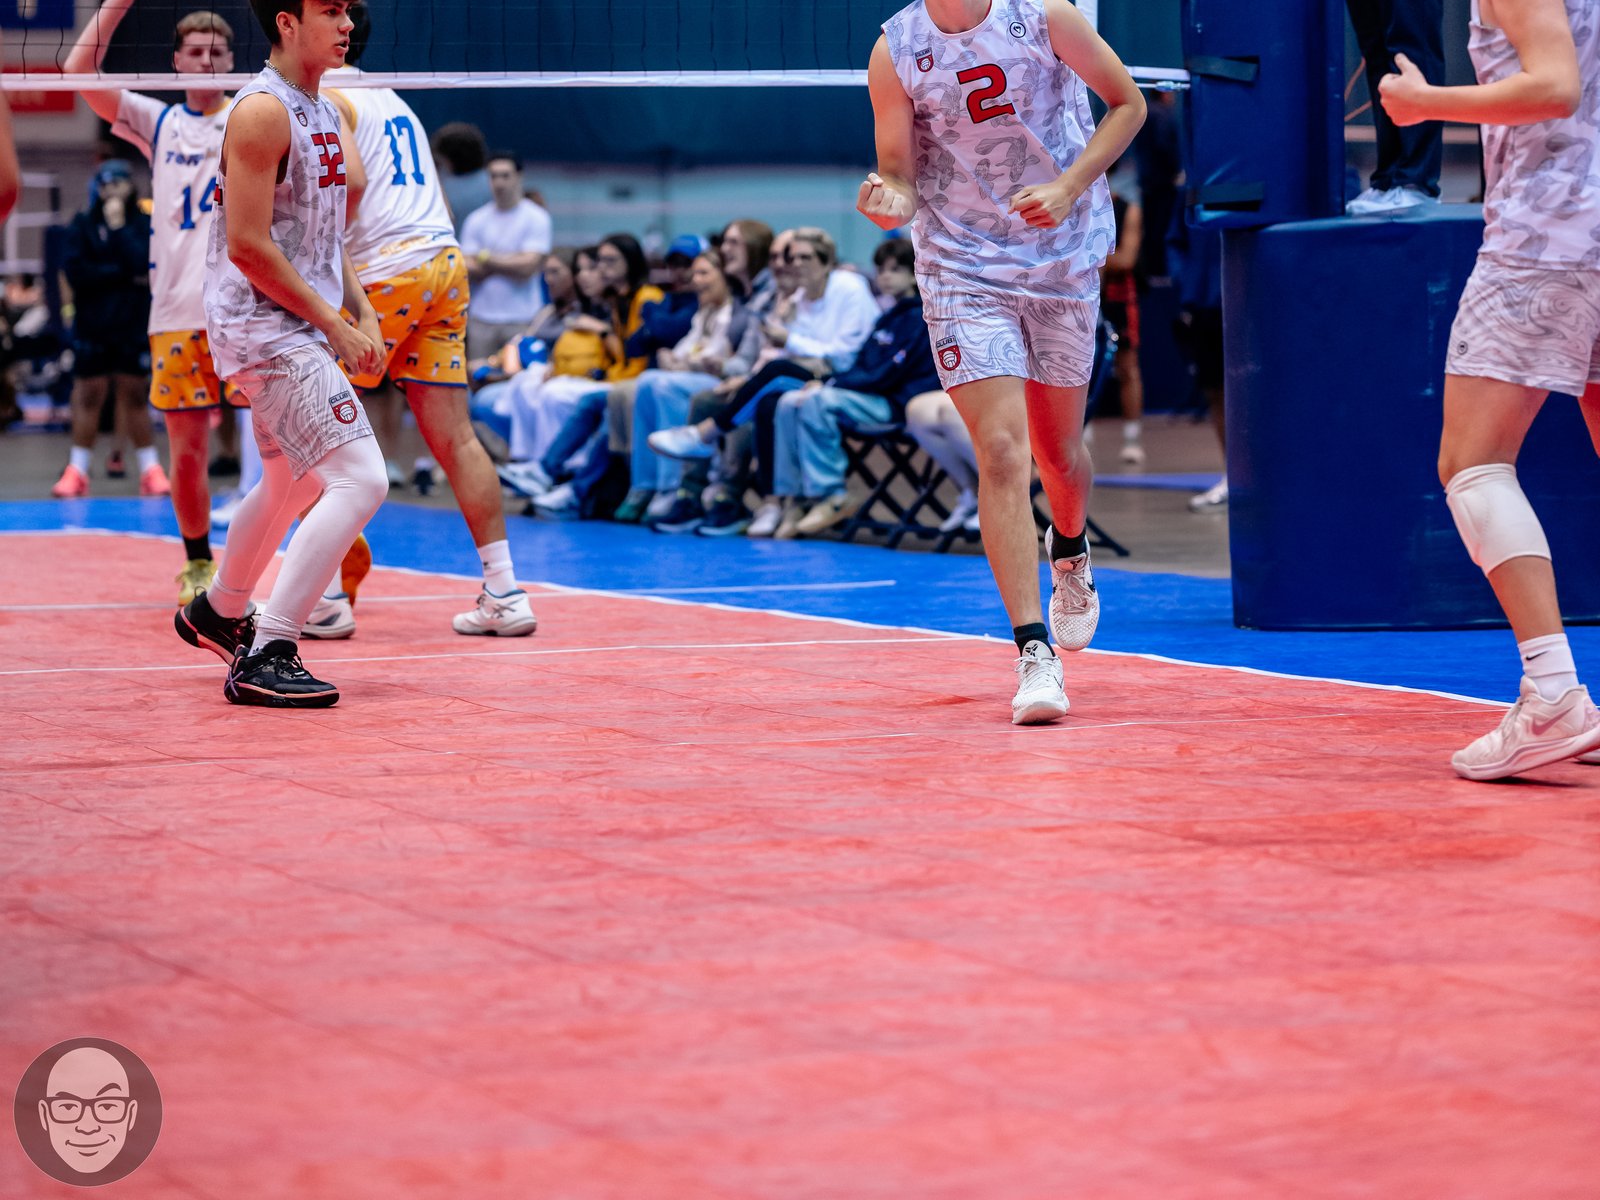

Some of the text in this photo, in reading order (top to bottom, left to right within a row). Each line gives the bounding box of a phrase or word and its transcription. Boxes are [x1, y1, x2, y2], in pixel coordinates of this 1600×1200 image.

[956, 63, 1016, 125] 2
[311, 132, 346, 189] 32
[384, 115, 425, 186] 17
